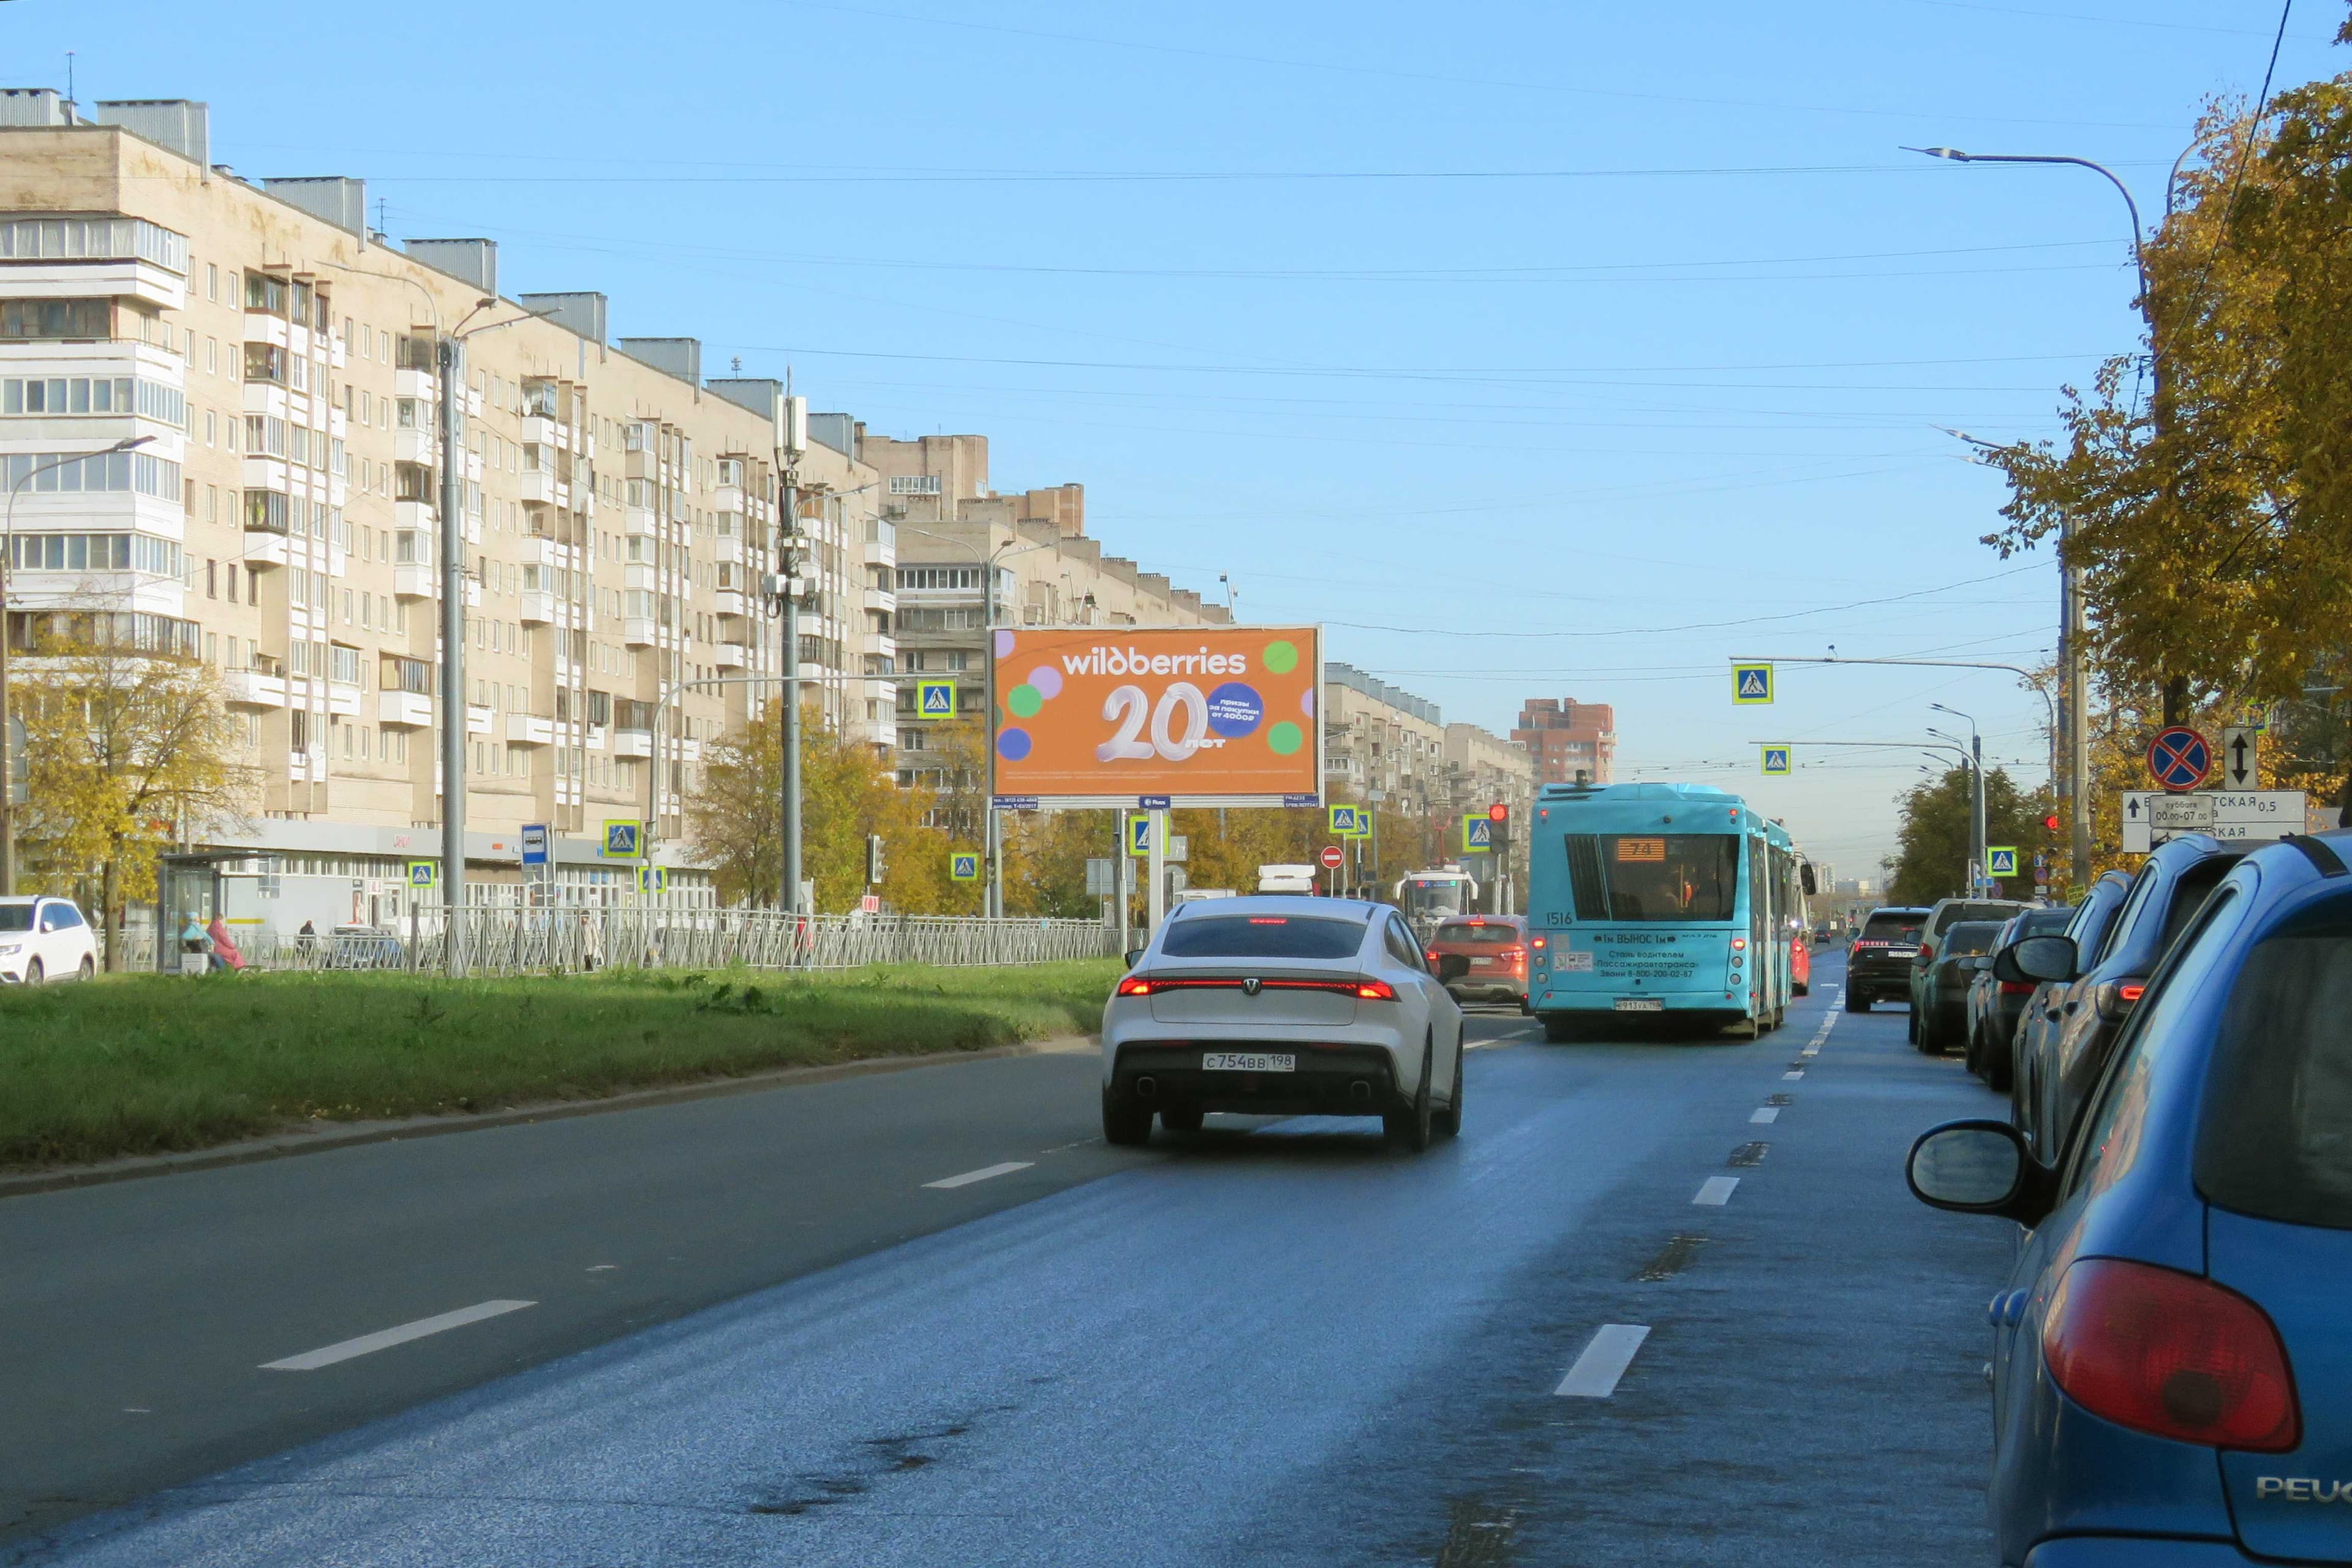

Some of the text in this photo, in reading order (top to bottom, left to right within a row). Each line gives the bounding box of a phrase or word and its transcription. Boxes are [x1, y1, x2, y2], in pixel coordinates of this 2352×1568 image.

[1062, 646, 1246, 676] wildberries
[1219, 699, 1250, 707] призы
[1221, 706, 1260, 715] покупки
[1096, 681, 1209, 763] 20
[1184, 738, 1226, 749] лет
[2165, 801, 2198, 809] суббота
[2258, 801, 2277, 812] 0.5
[1547, 911, 1573, 925] 1516
[1616, 933, 1653, 944] ВЫНОС
[1608, 950, 1635, 959] Стань
[1207, 1055, 1292, 1069] С754ВВ 198
